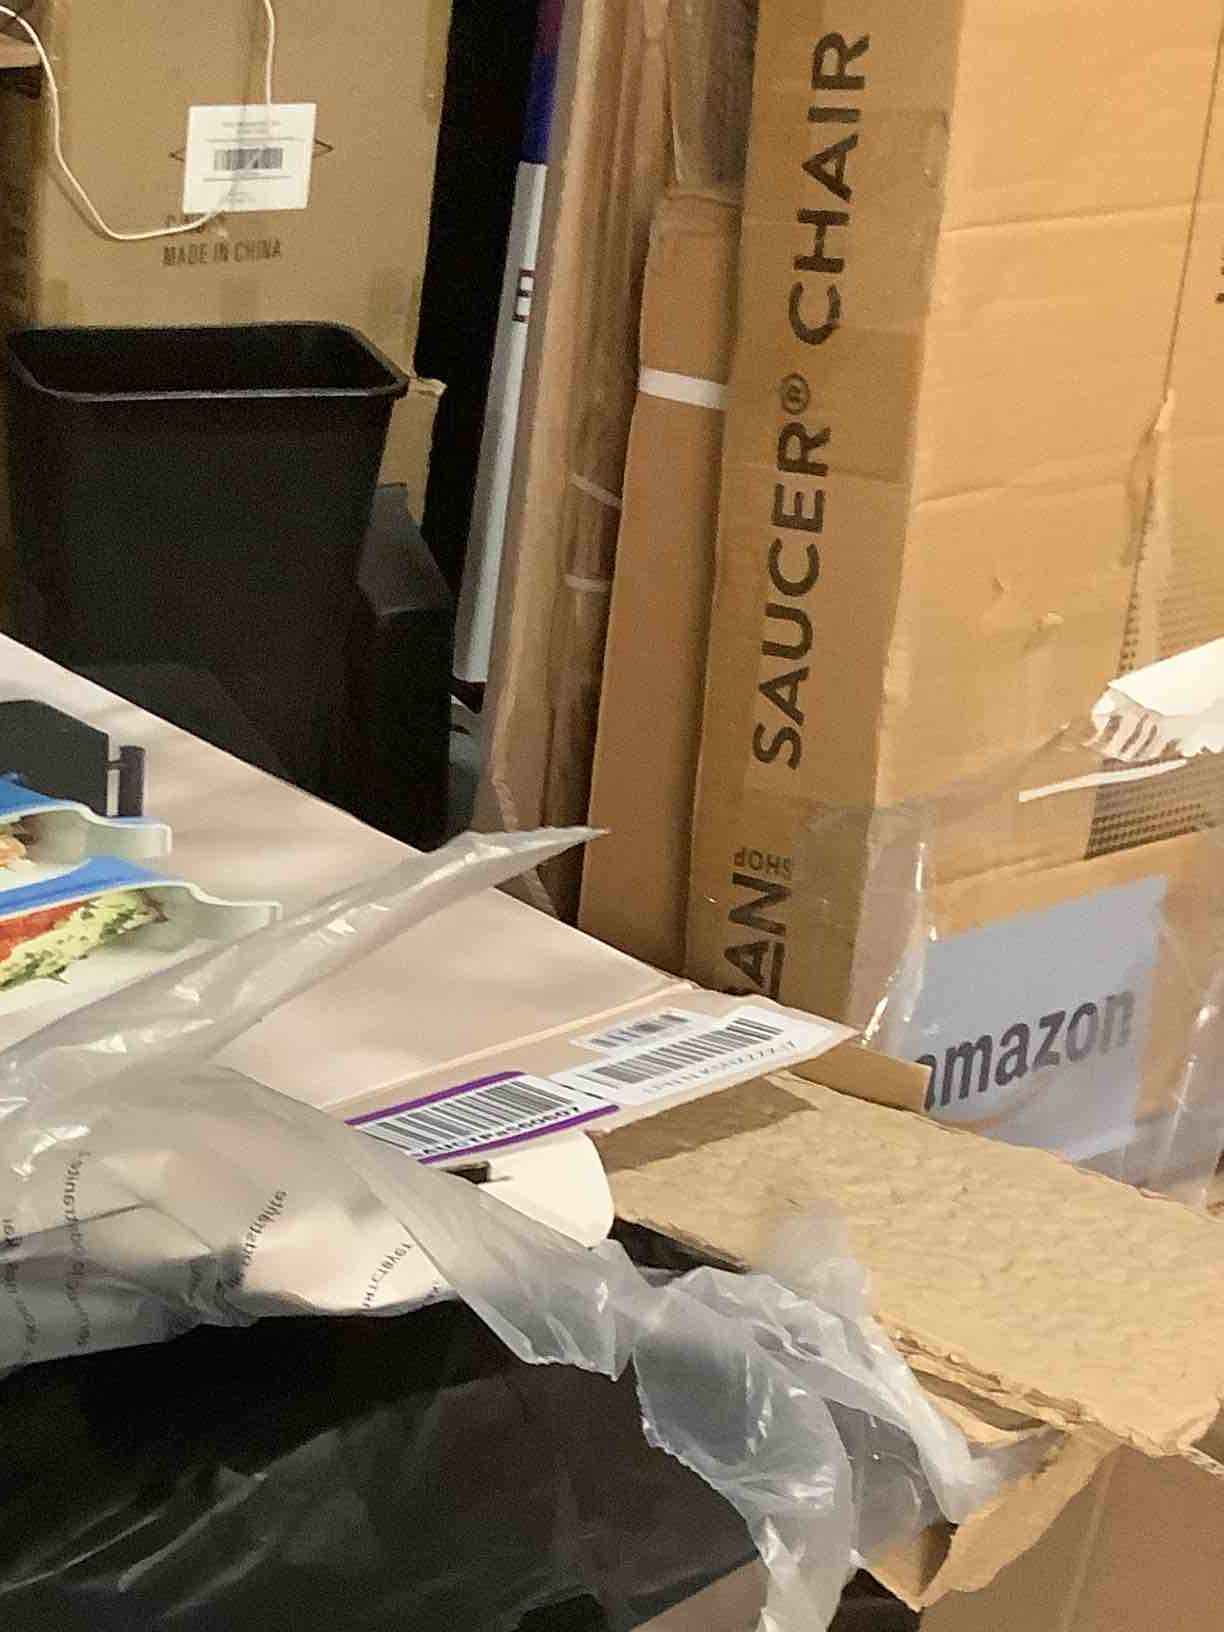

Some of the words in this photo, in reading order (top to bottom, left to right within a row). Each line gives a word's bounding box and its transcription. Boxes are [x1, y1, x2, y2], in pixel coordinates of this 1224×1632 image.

[163, 243, 208, 267] MADE
[214, 242, 230, 263] IN
[233, 238, 281, 263] CHINA
[788, 30, 872, 345] CHAIR
